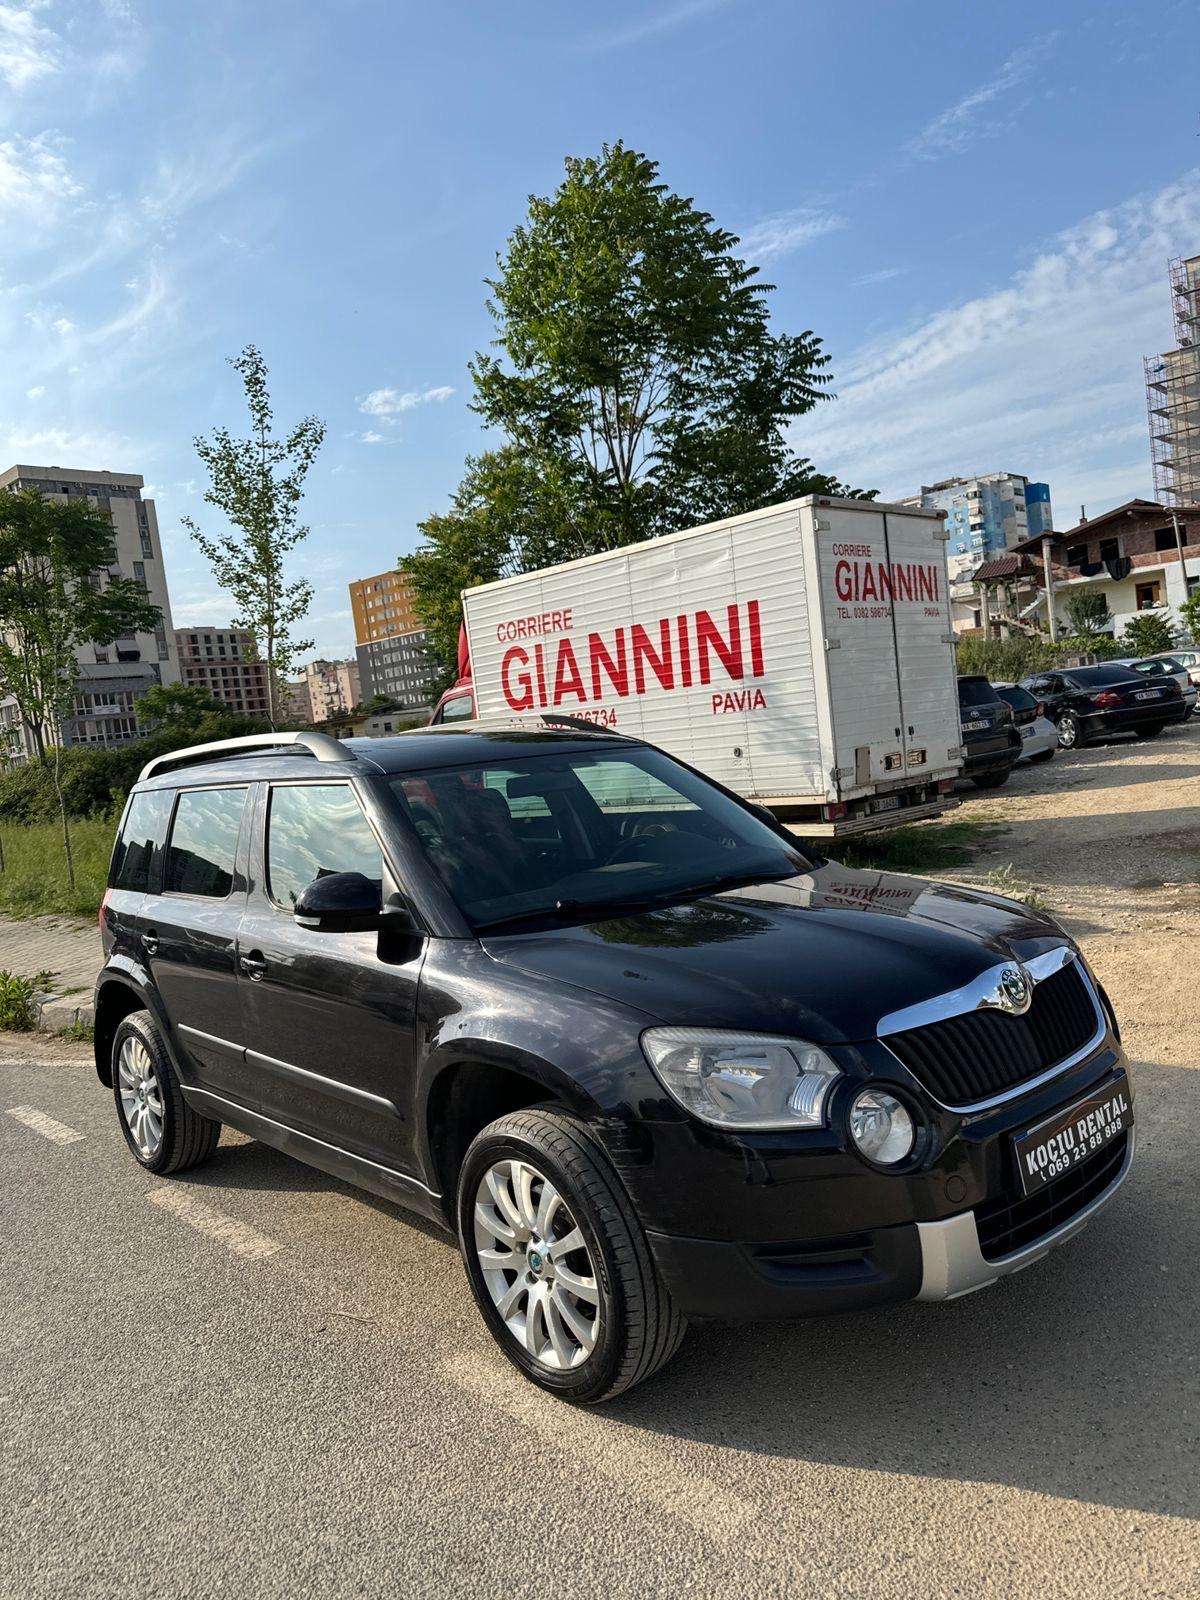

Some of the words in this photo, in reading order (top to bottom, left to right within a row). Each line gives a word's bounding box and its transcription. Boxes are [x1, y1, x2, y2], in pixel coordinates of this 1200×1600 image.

[833, 543, 872, 557] CORRIERE
[835, 560, 939, 602] GIANNINI
[497, 608, 573, 643] CORRIERE
[923, 607, 940, 617] PAVIA
[500, 599, 765, 712] GIANNINI
[711, 689, 767, 713] PAVIA
[1077, 1093, 1128, 1142] RENTAL
[1048, 1154, 1070, 1177] 069
[1073, 1143, 1087, 1161] 23
[1089, 1131, 1103, 1149] 88
[1105, 1117, 1122, 1138] 888
